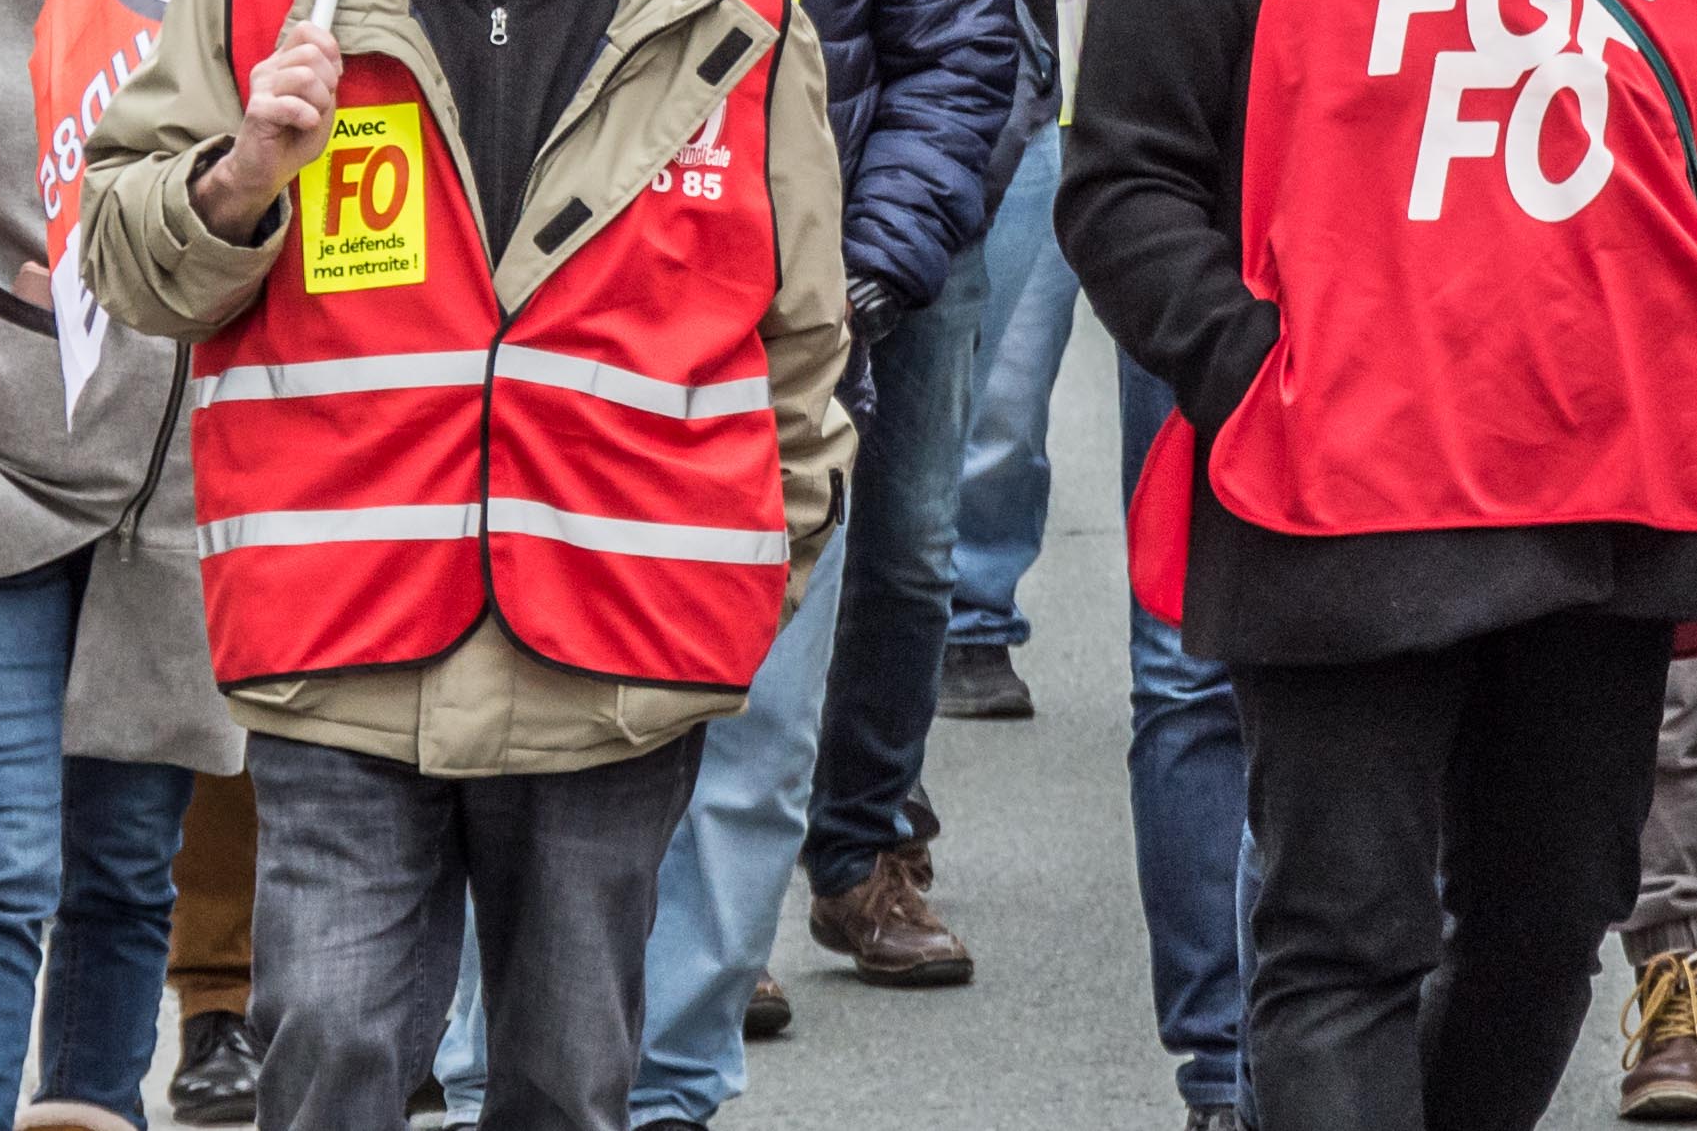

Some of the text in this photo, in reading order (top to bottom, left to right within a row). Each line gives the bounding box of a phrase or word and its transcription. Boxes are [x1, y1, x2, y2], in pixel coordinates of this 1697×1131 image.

[333, 119, 386, 139] Avec
[1407, 51, 1614, 222] FO
[324, 144, 410, 236] FO
[682, 170, 722, 200] 85
[317, 232, 405, 260] je défends
[313, 263, 344, 279] ma
[349, 255, 409, 276] retraite
